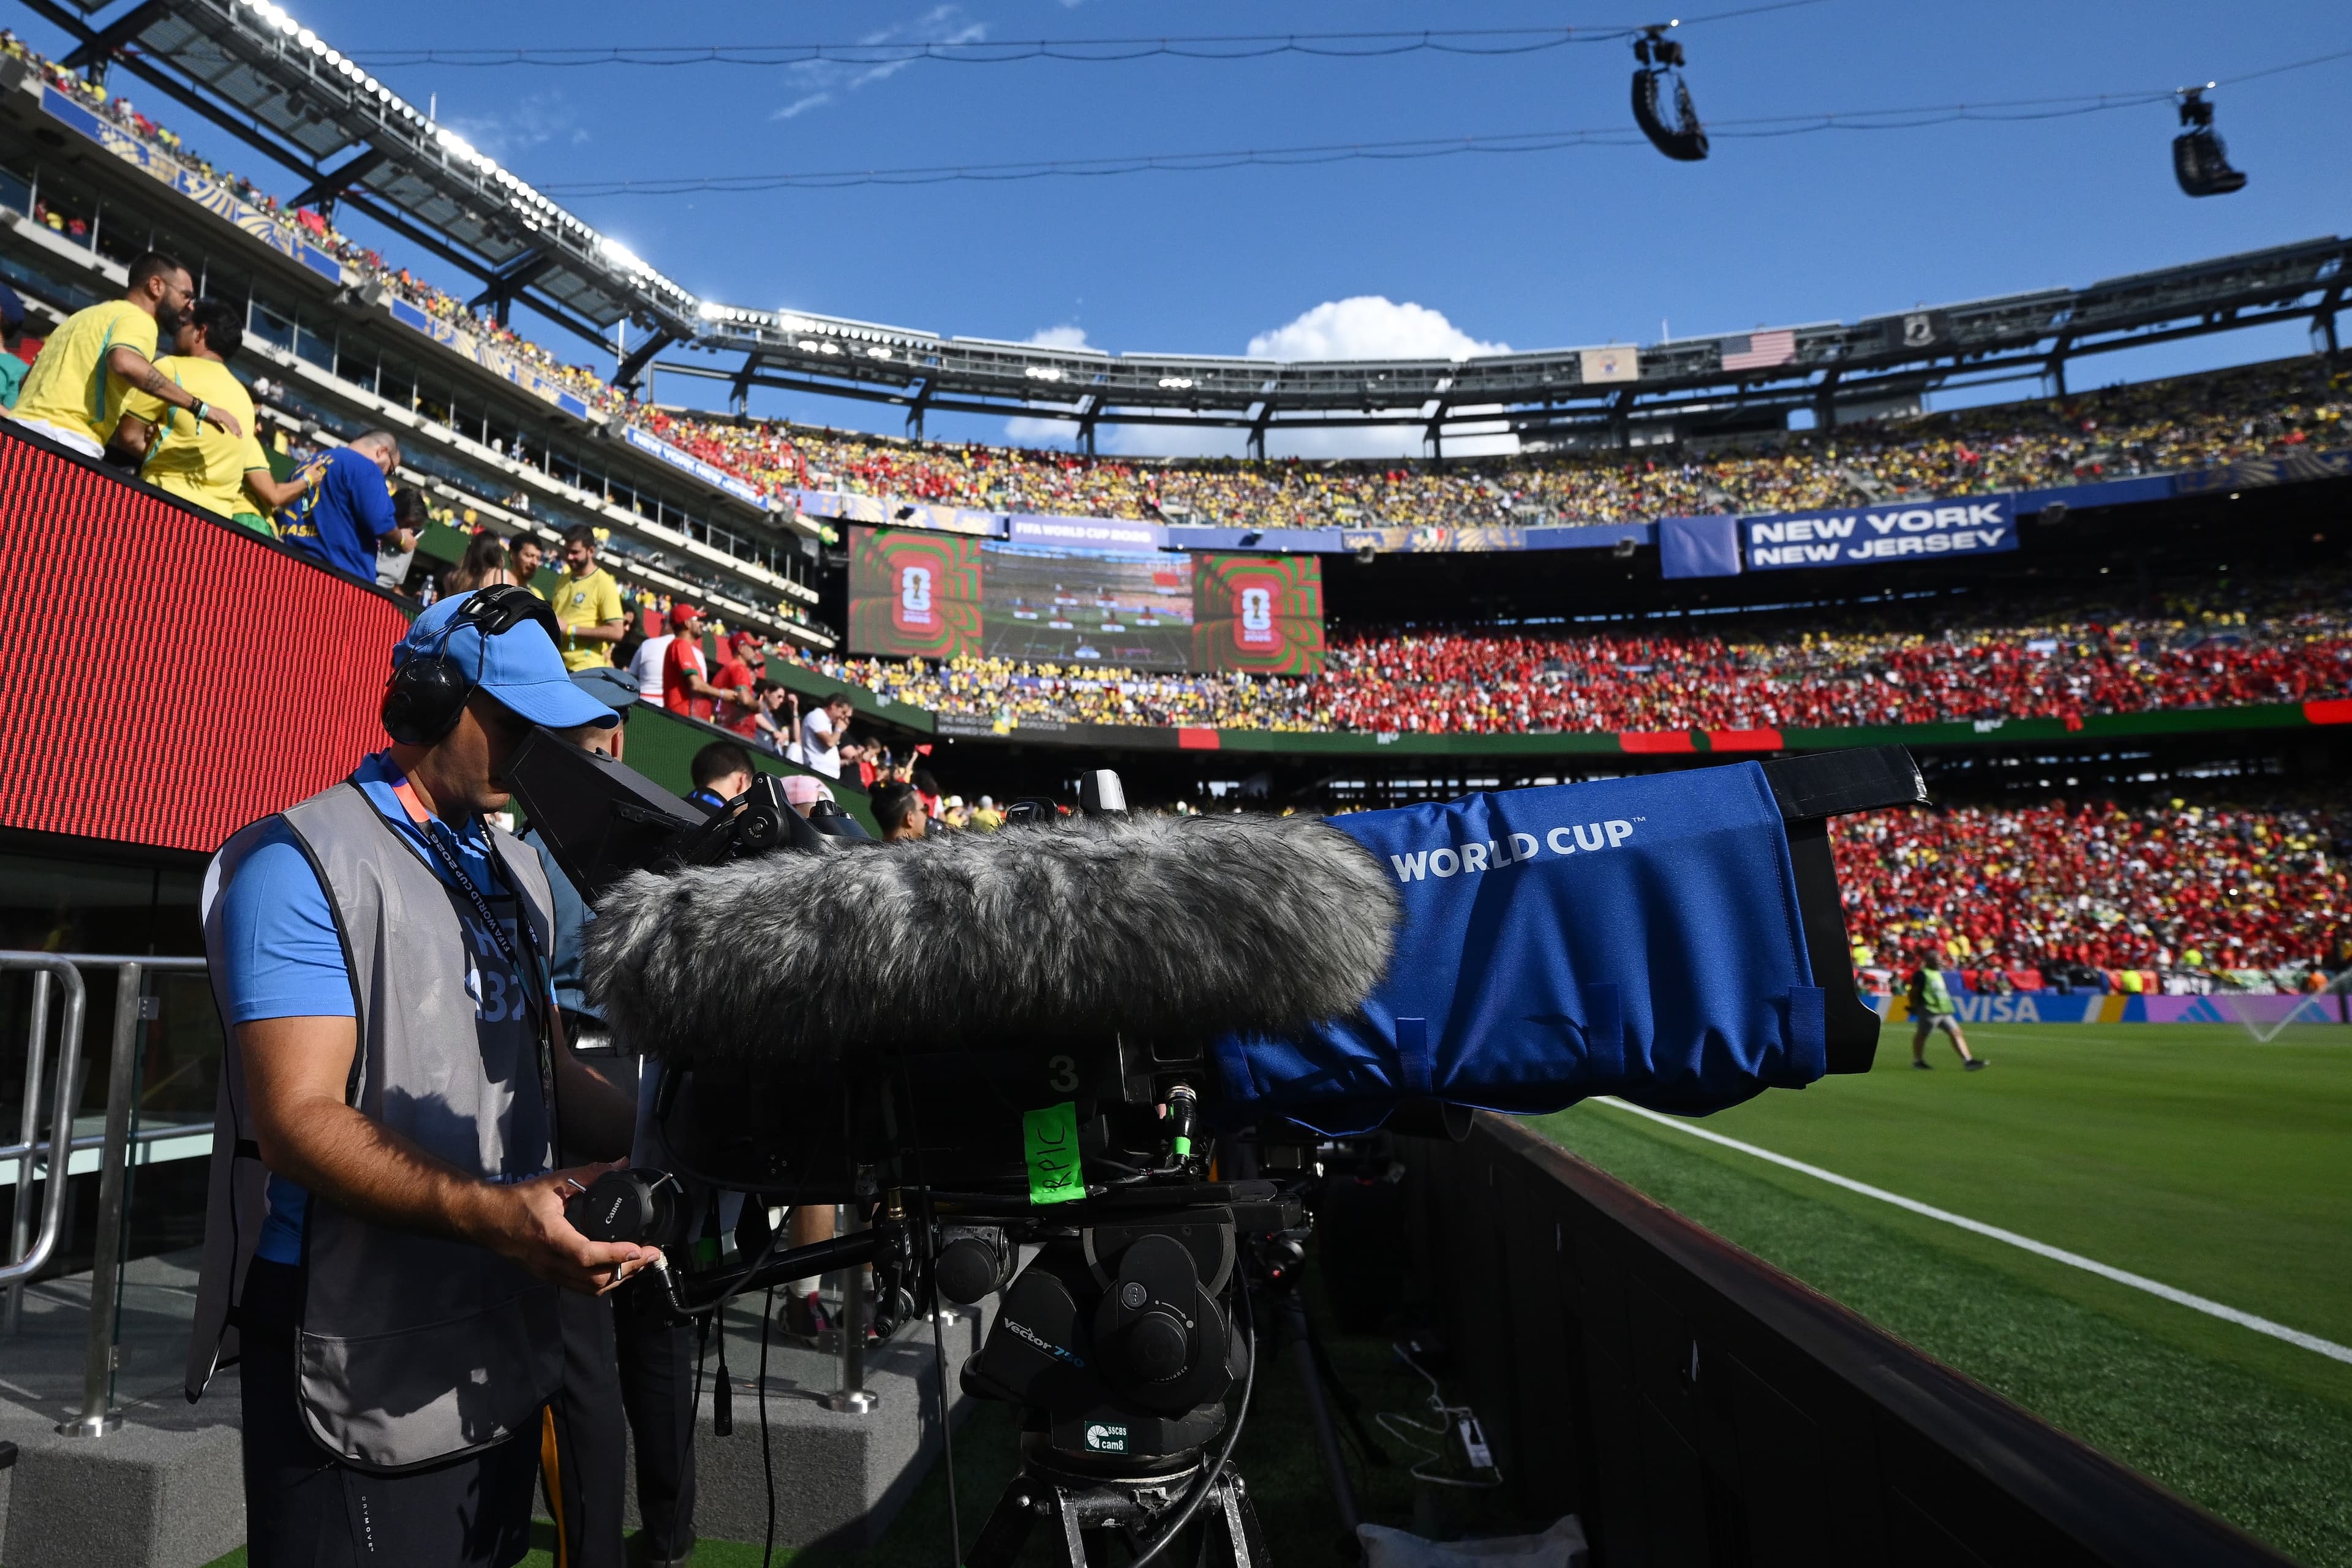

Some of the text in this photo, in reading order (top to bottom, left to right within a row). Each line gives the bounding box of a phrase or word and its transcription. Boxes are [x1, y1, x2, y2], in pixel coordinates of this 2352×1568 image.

[1015, 522, 1041, 535] FIFA
[1042, 524, 1085, 538] WORLD
[1086, 526, 1110, 540] CUP
[1752, 502, 2003, 545] NEW YORK
[1753, 527, 2006, 567] NEW JERSEY
[1390, 832, 1540, 883] WORLD
[430, 833, 510, 952] FIFA WORLD CUP 2026
[1952, 995, 2041, 1022] VISA
[1049, 1054, 1079, 1093] 3
[1036, 1125, 1072, 1189] RPIC
[605, 1197, 623, 1224] Canon
[1004, 1317, 1086, 1368] Vector 750
[1101, 1439, 1124, 1451] cam8
[1107, 1426, 1127, 1436] SSCBS
